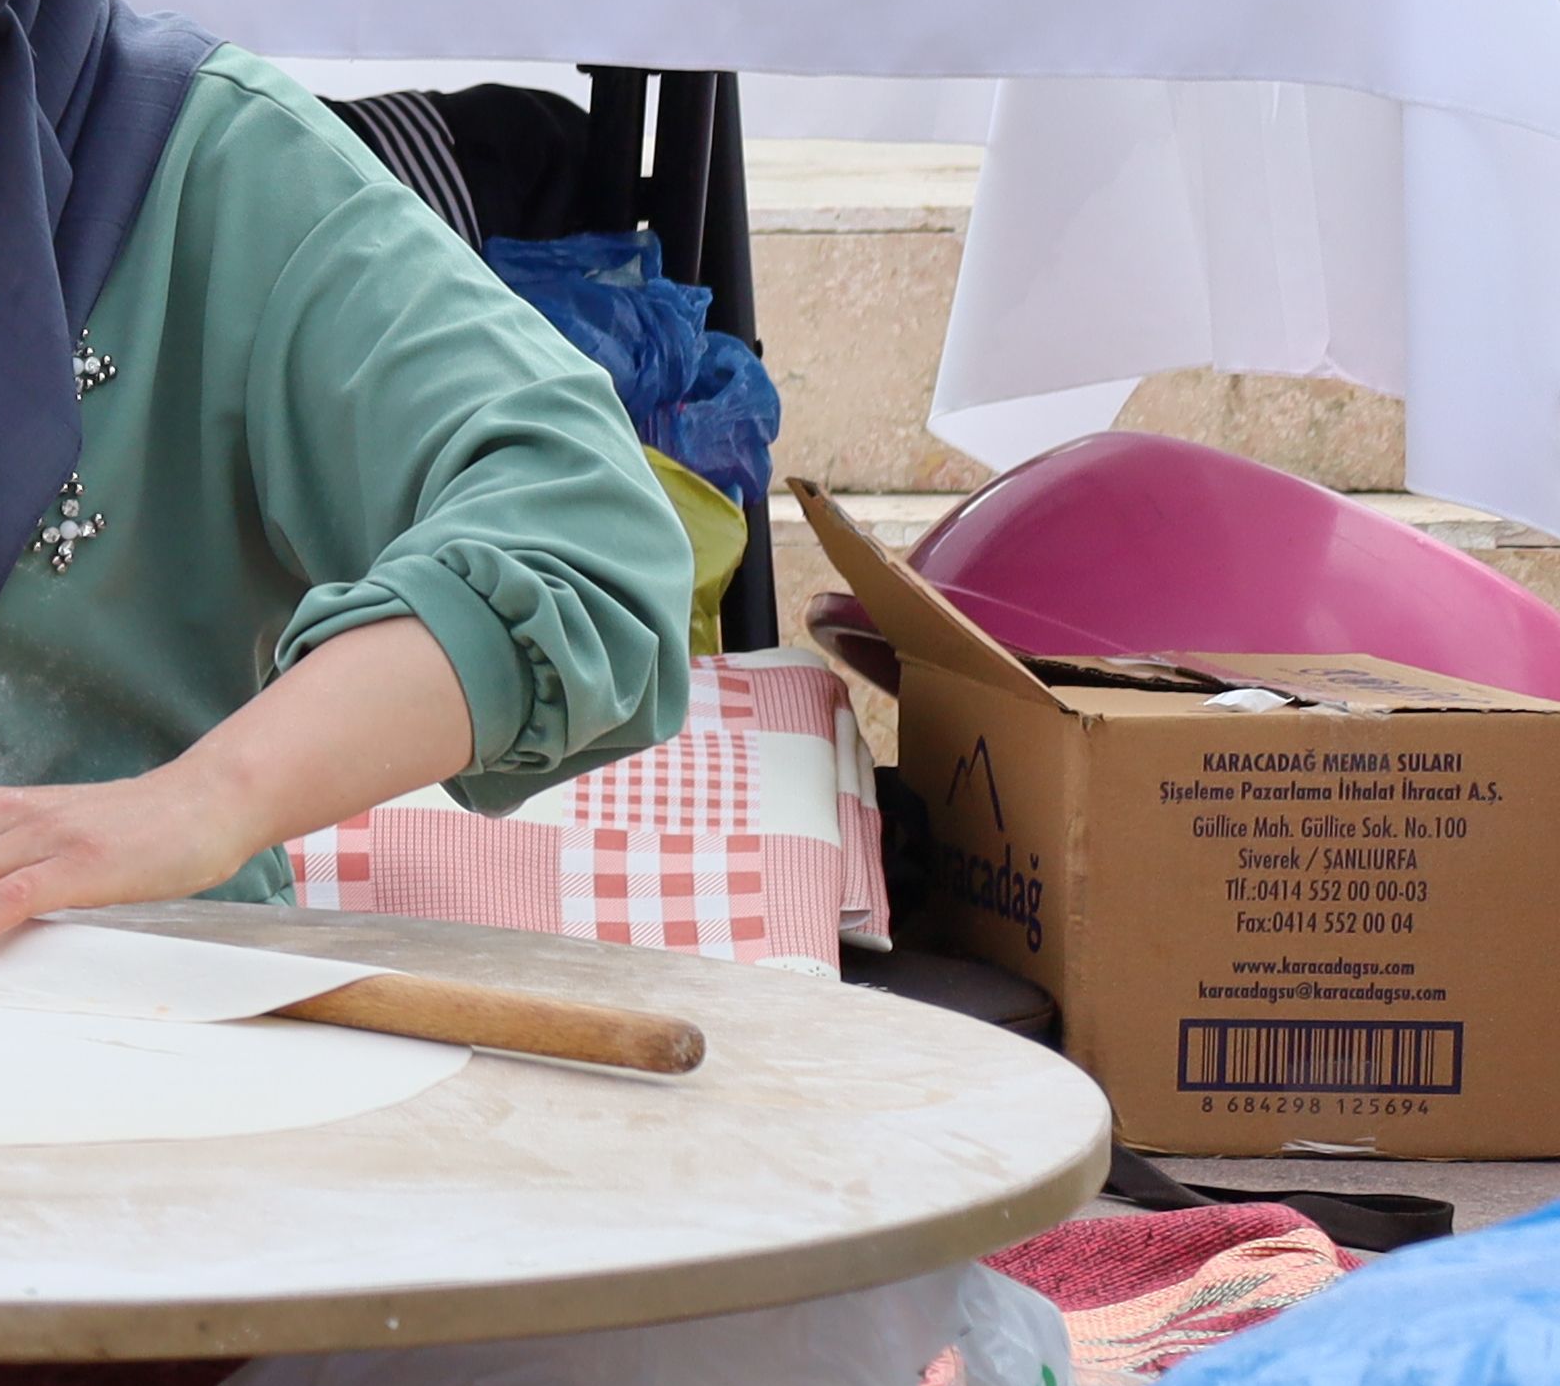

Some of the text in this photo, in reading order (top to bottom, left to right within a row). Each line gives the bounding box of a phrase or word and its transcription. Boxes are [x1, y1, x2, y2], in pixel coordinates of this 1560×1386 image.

[1203, 748, 1462, 773] KARACADAĞ MEMBA SULARI
[1159, 777, 1503, 805] Şişeleme Pazarlama İthalat İhracat A.Ş.
[1192, 816, 1467, 839] Güllice Mah. Güllice Sok. No.100
[1238, 848, 1417, 874] Siverek / ŞANLIURFA
[1225, 879, 1428, 902] Tlf.:0414 552 00 00-03
[1237, 911, 1414, 934] Fax:0414 552 00 04
[1232, 957, 1415, 979] www.karacadagsu.com
[1198, 981, 1446, 1005] karacadagsu@karacadagsu.com
[1201, 1097, 1429, 1115] 8 684298 125694
